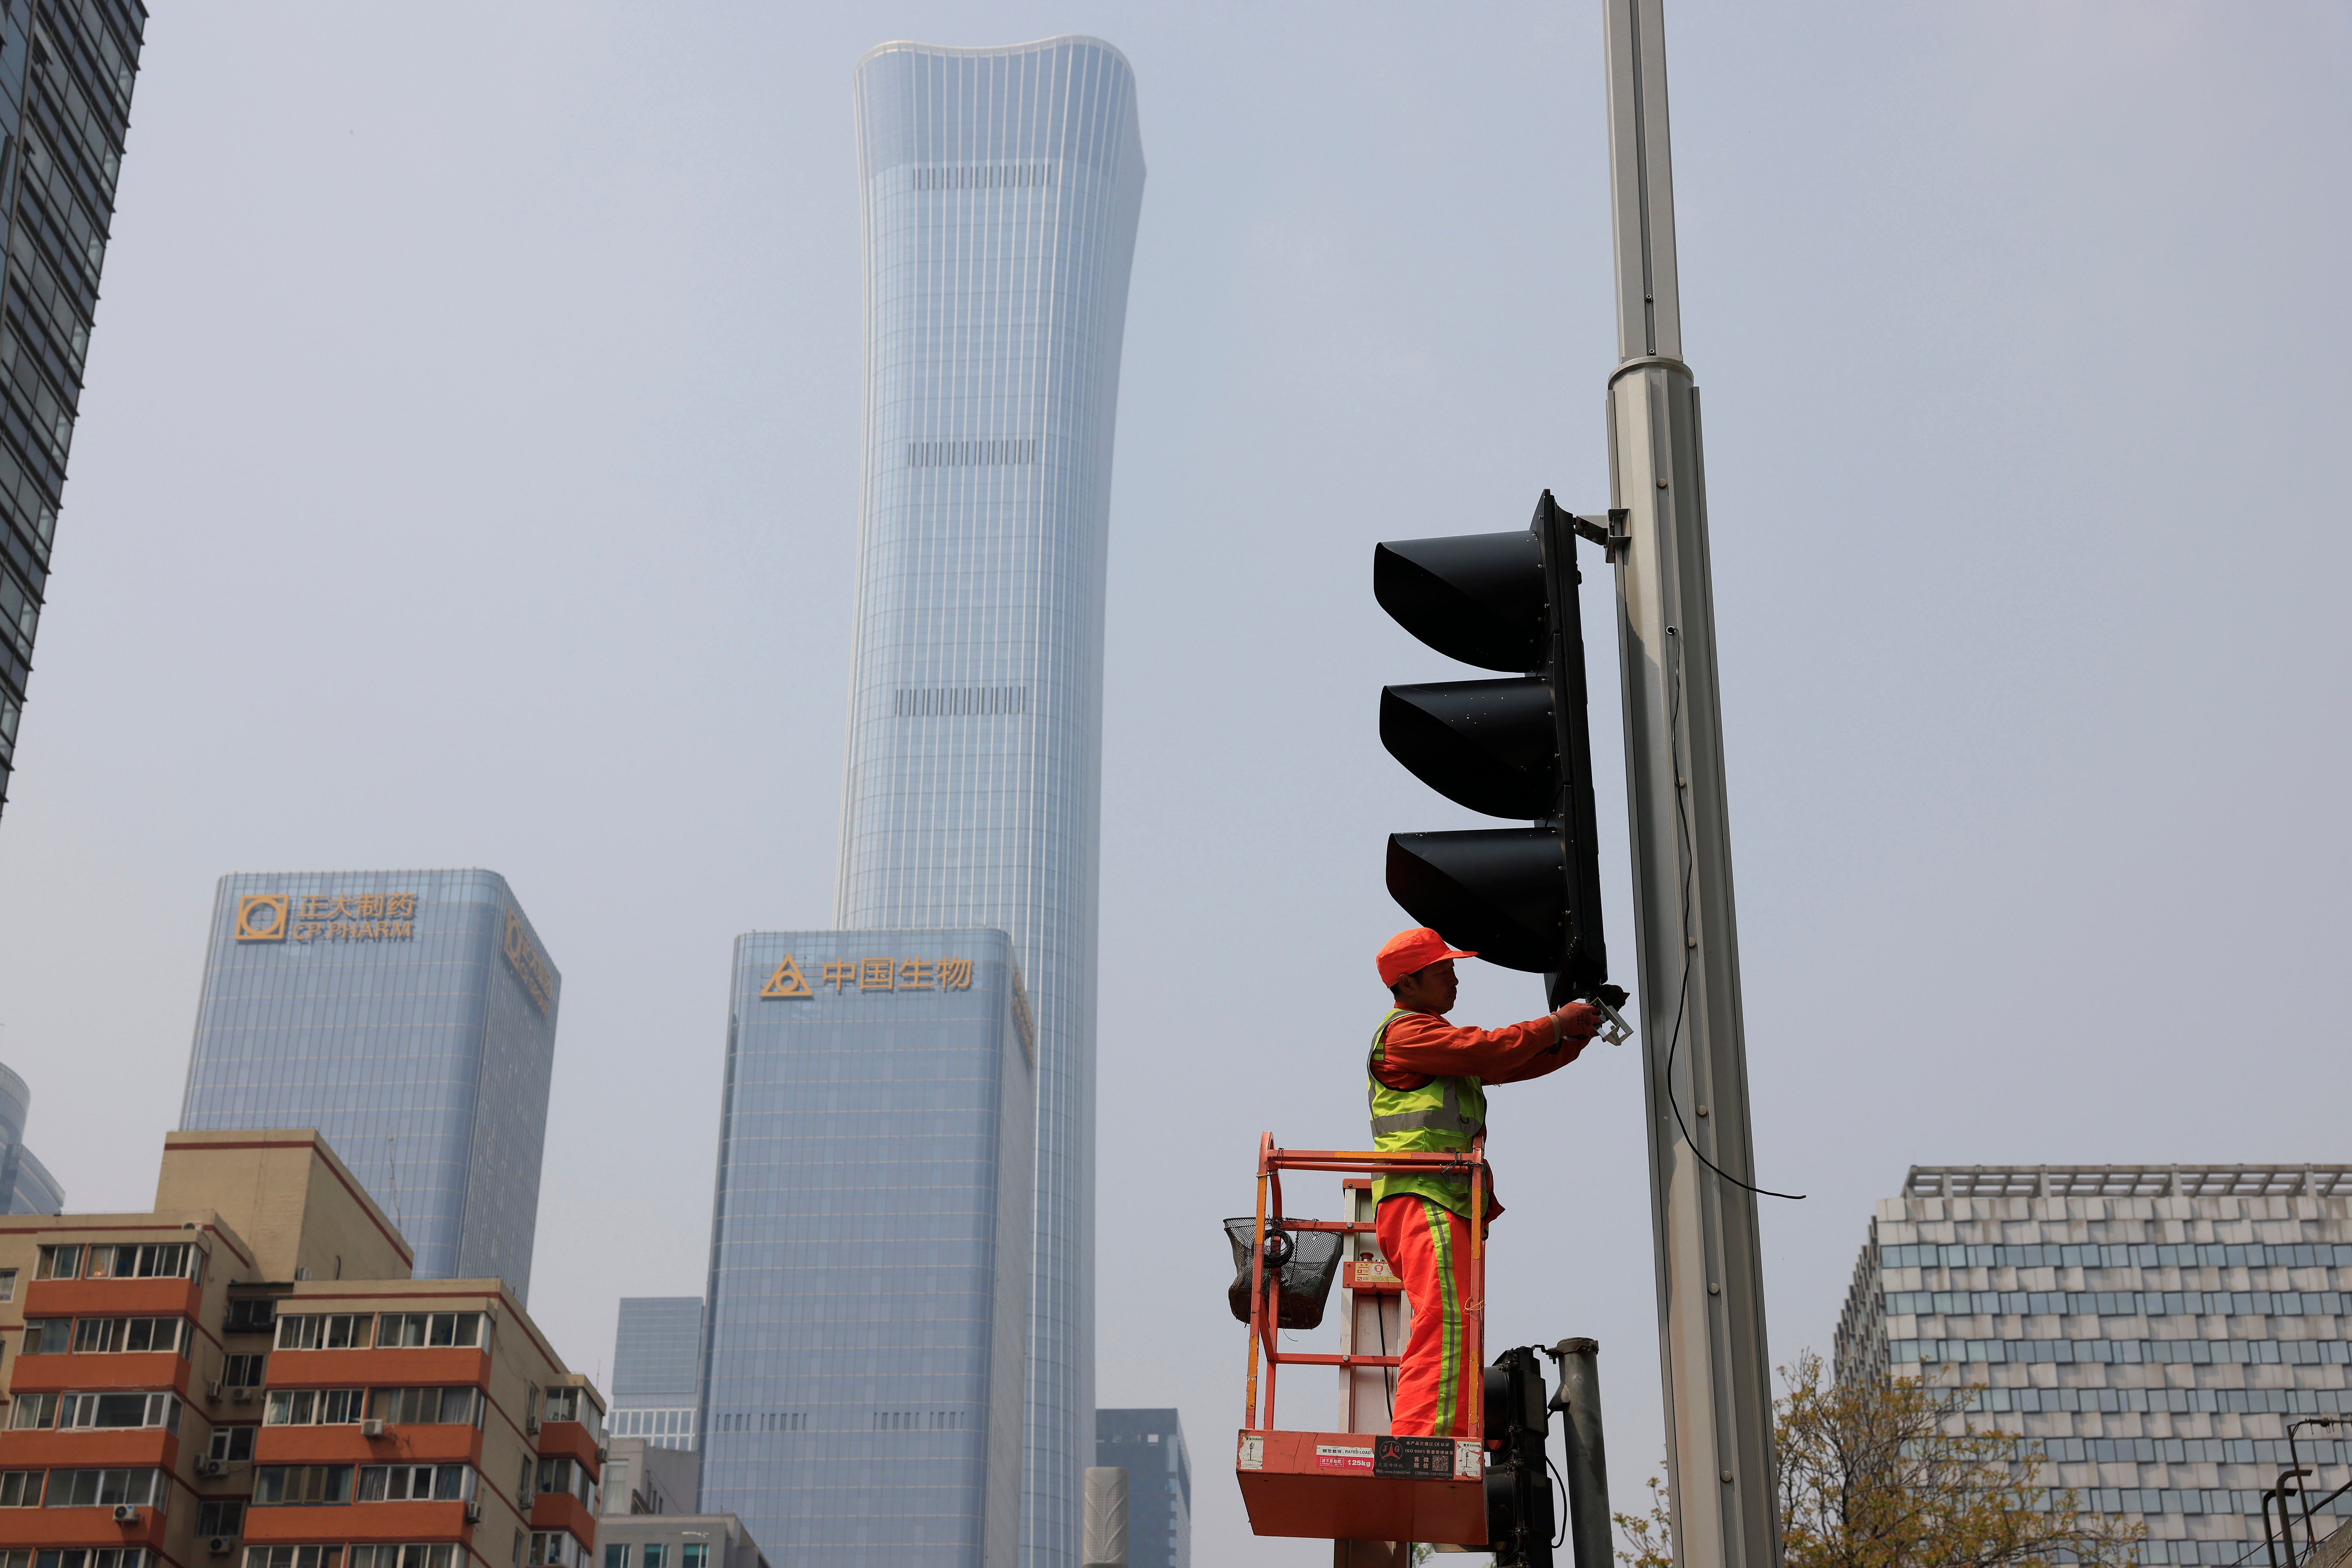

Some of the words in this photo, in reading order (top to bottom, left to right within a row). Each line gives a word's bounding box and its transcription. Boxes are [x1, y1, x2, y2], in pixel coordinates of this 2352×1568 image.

[296, 891, 415, 918] 正大制药
[293, 922, 321, 940] CP
[328, 921, 411, 938] PHARM
[823, 955, 973, 991] 中国生物
